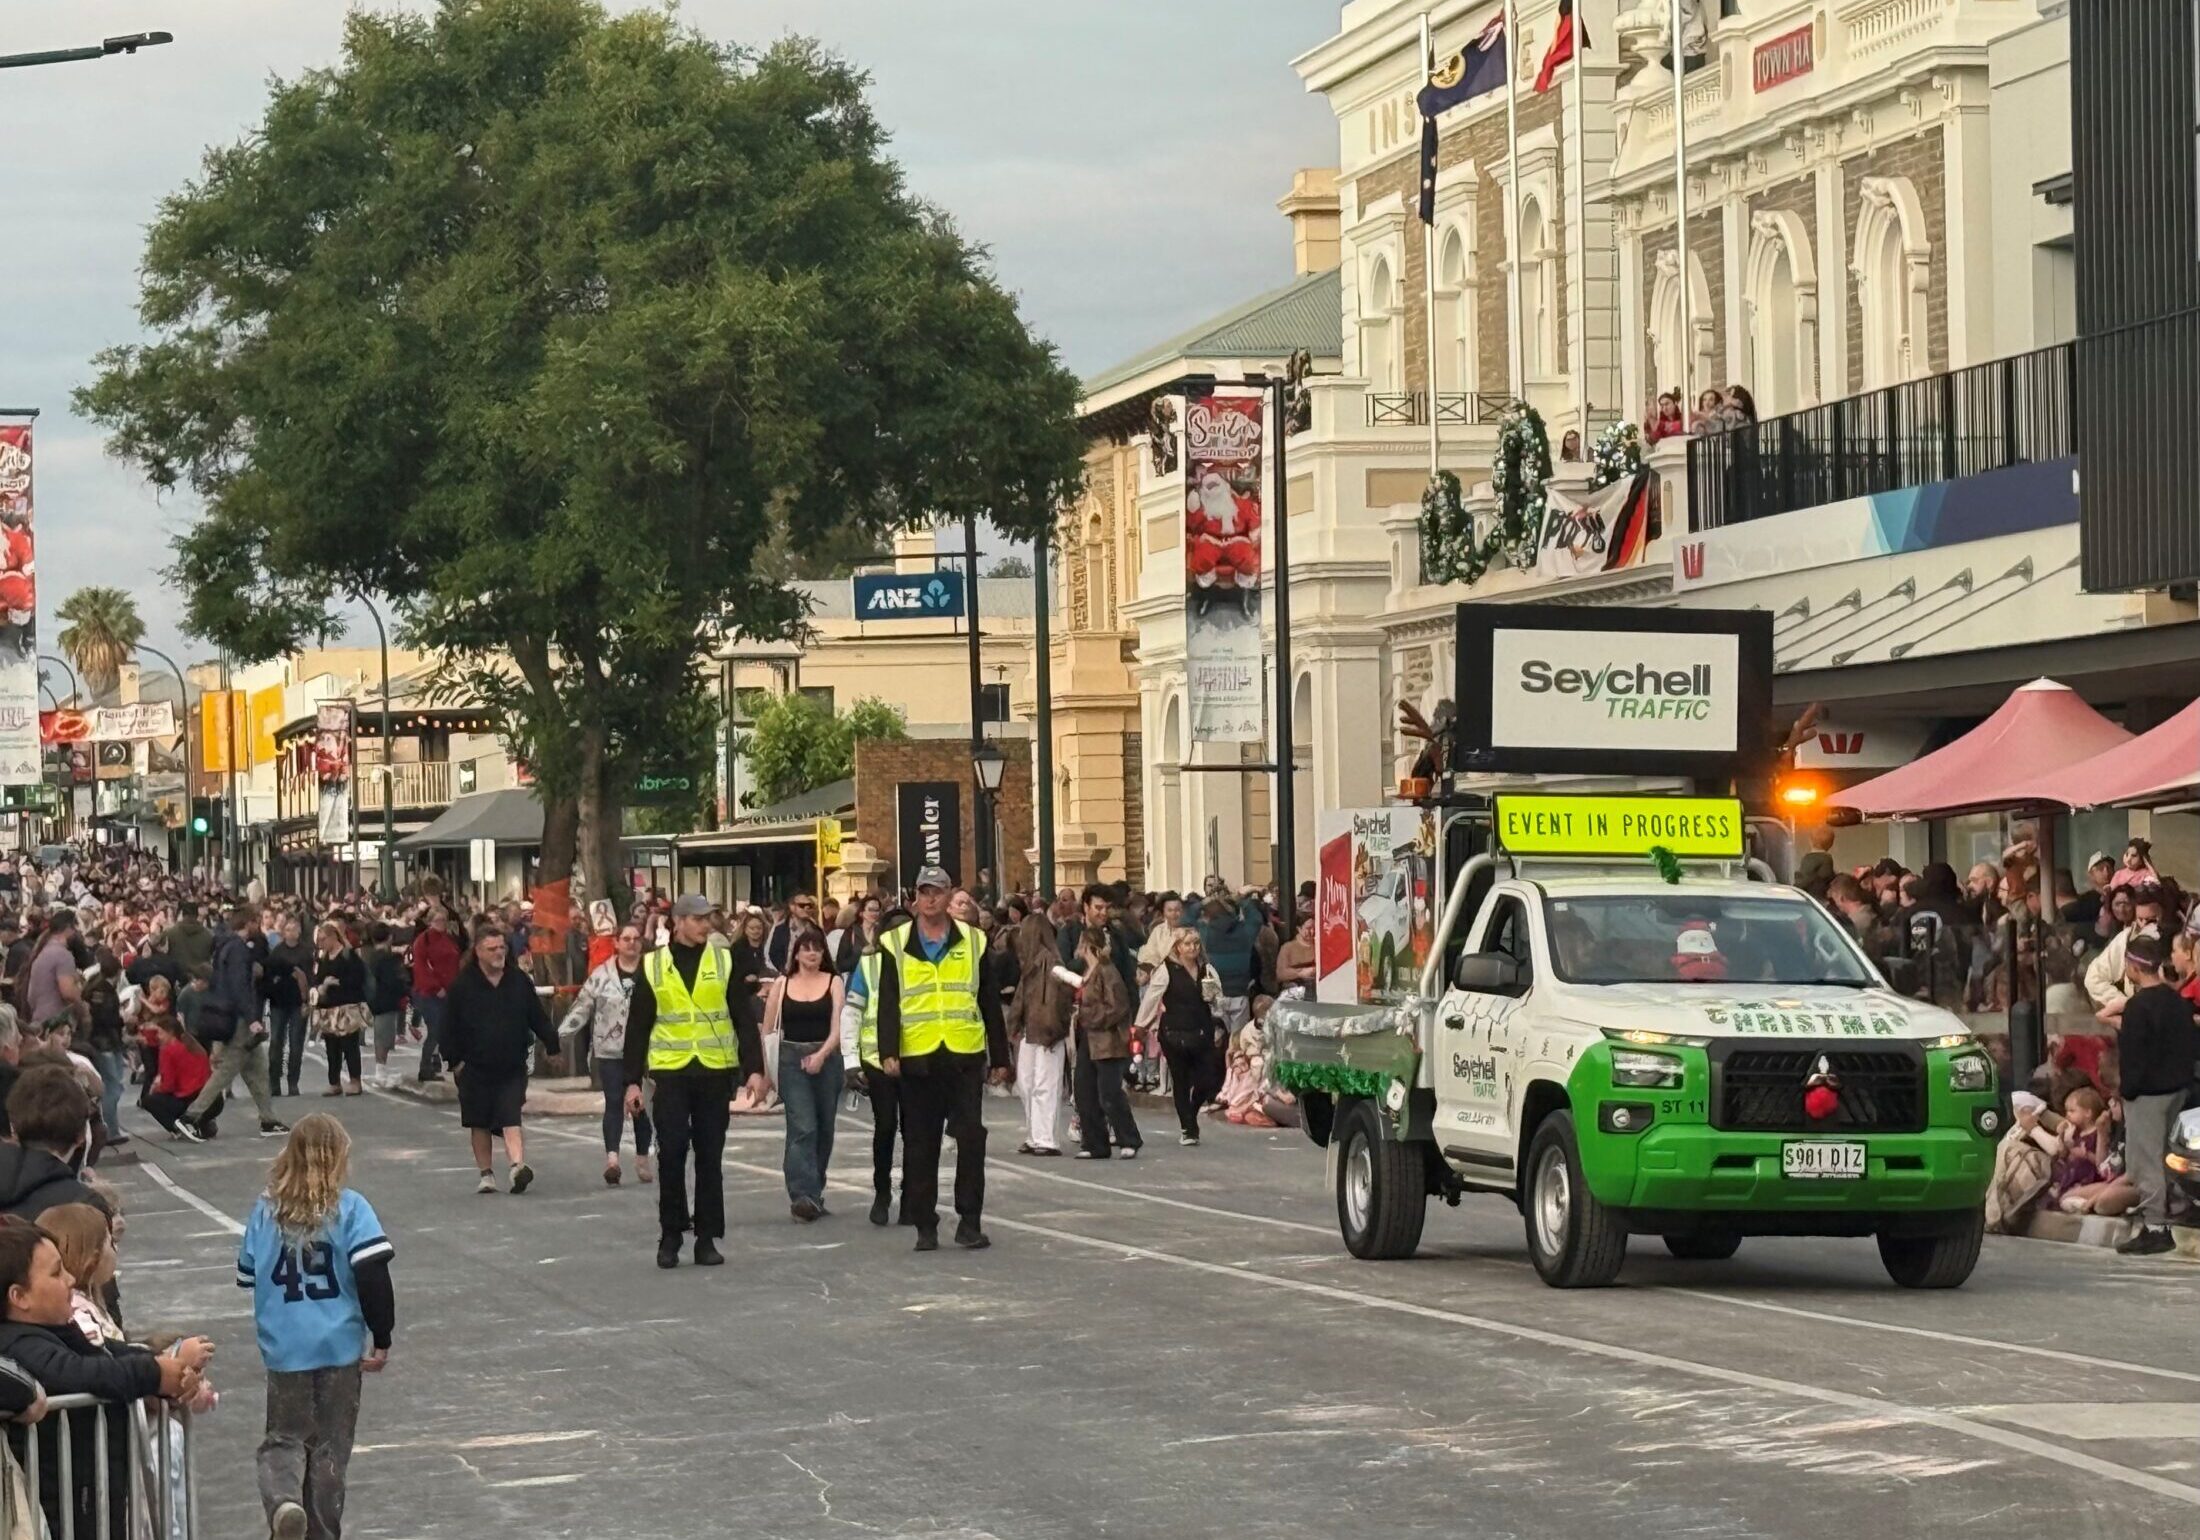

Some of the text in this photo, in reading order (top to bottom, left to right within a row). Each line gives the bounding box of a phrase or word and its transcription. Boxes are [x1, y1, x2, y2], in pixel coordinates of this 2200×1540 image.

[1756, 41, 1789, 84] TOWN
[867, 588, 922, 610] ANZ
[1520, 660, 1711, 702] Seychell
[1606, 696, 1711, 721] TRAFFIC
[920, 795, 940, 866] awler
[1508, 812, 1730, 839] EVENT IN PROGRESS
[1661, 1100, 1704, 1114] ST 11
[1831, 1147, 1863, 1168] DIZ
[271, 1240, 341, 1304] 49
